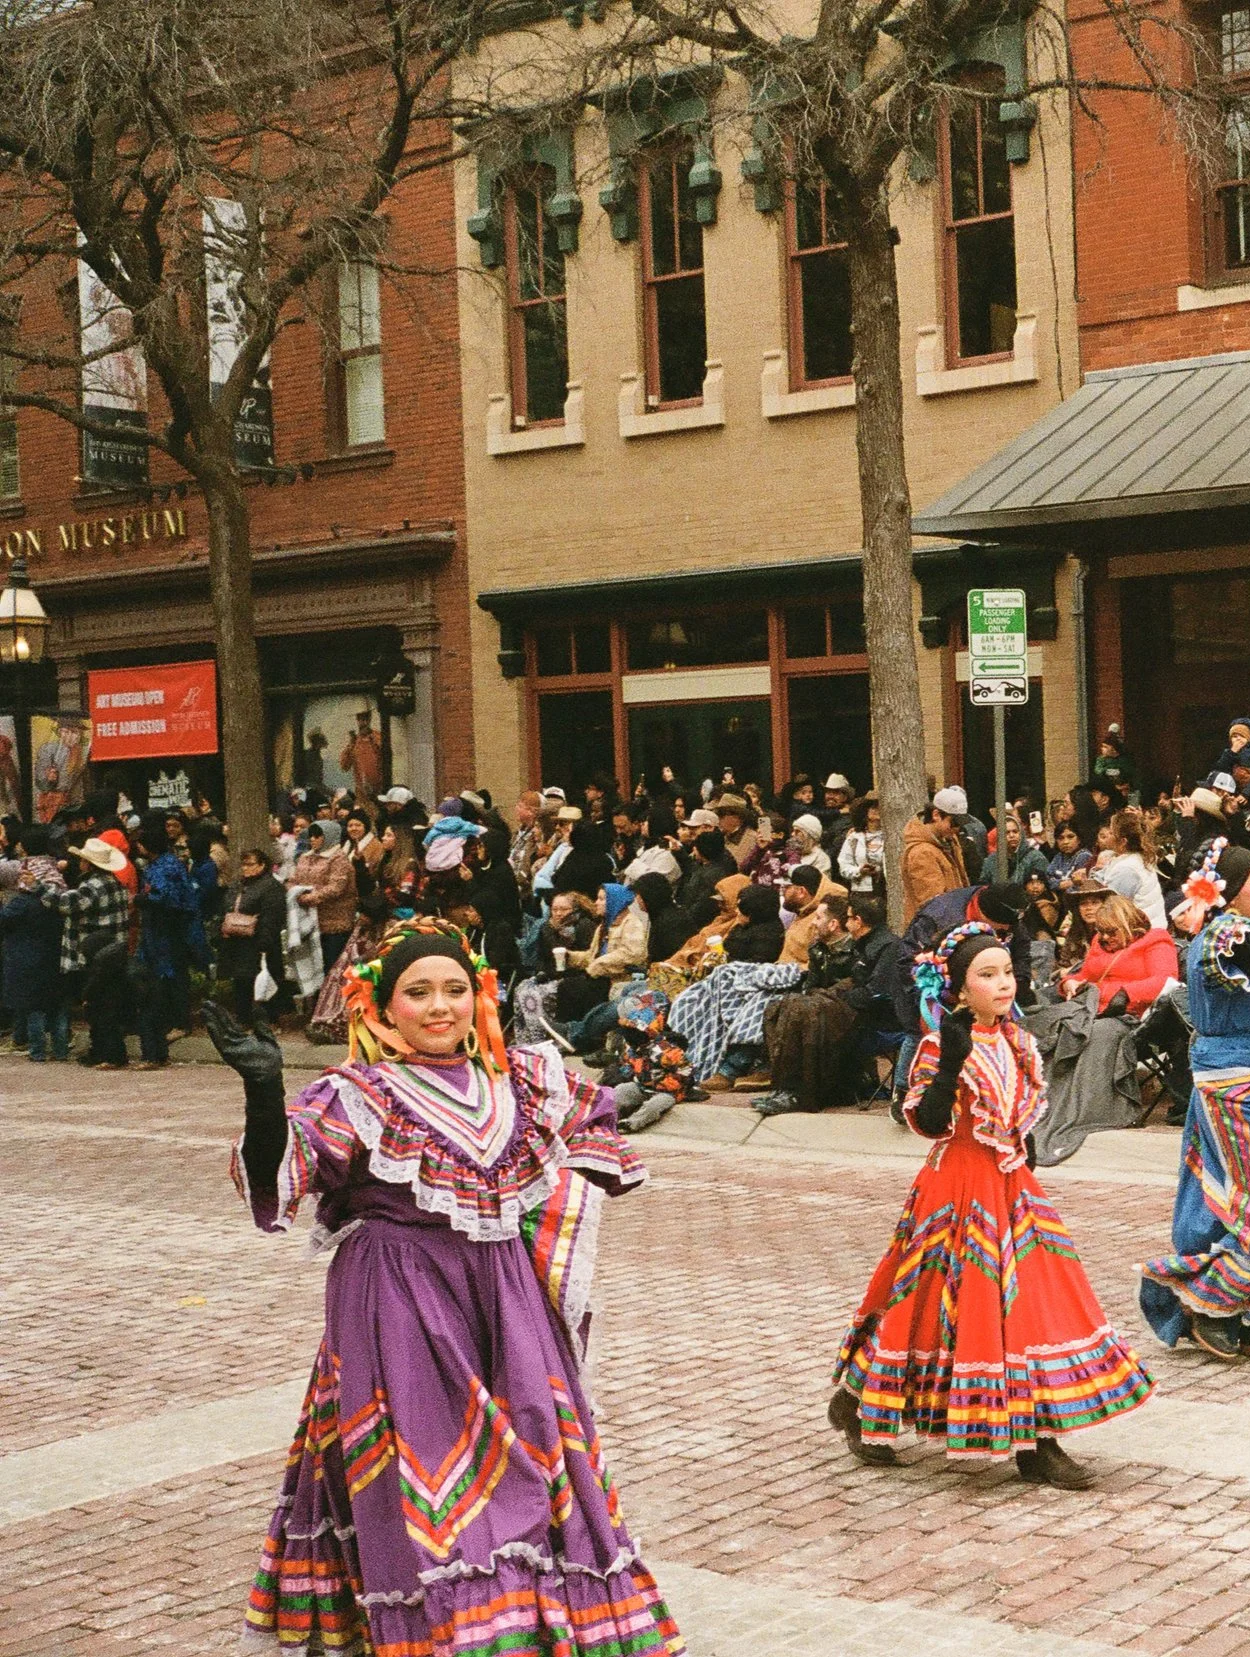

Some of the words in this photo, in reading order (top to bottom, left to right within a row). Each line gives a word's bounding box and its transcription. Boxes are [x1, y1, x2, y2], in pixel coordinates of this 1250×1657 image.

[235, 431, 271, 446] SEUM
[89, 449, 146, 465] MUSEUM
[0, 529, 43, 558] ON
[58, 509, 186, 552] MUSEUM
[973, 596, 981, 606] 5
[979, 609, 1015, 617] PASSENGER
[985, 617, 1011, 625] LOADING
[988, 625, 1007, 633] ONLY
[982, 644, 996, 653] MON
[1003, 644, 1015, 652] SAT
[111, 691, 144, 708] MUSEUM
[144, 690, 165, 706] OPEN
[96, 722, 117, 737] FREE
[119, 719, 166, 735] ADMISSION
